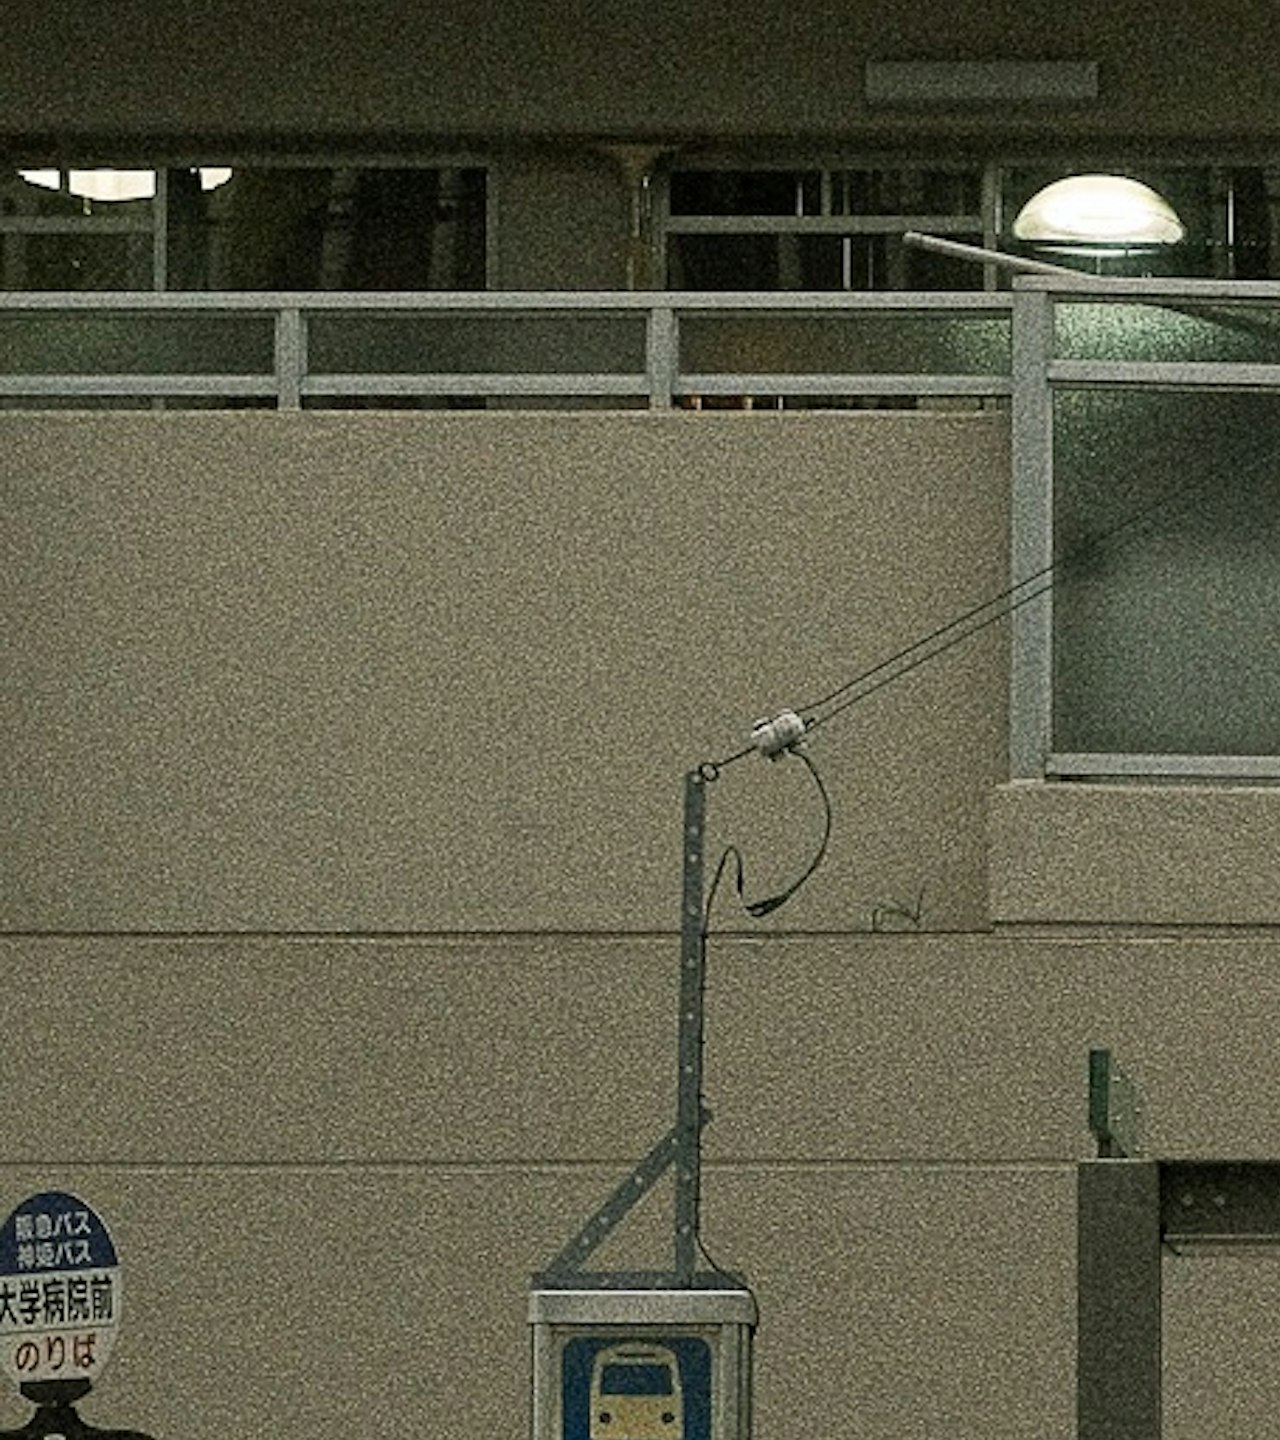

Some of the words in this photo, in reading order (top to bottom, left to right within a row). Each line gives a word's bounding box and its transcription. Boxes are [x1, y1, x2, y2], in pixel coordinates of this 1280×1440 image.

[15, 1211, 92, 1240] 阪急バス
[17, 1238, 93, 1269] 神姫バス
[0, 1276, 113, 1327] 大学病院前
[15, 1332, 97, 1373] のりば
